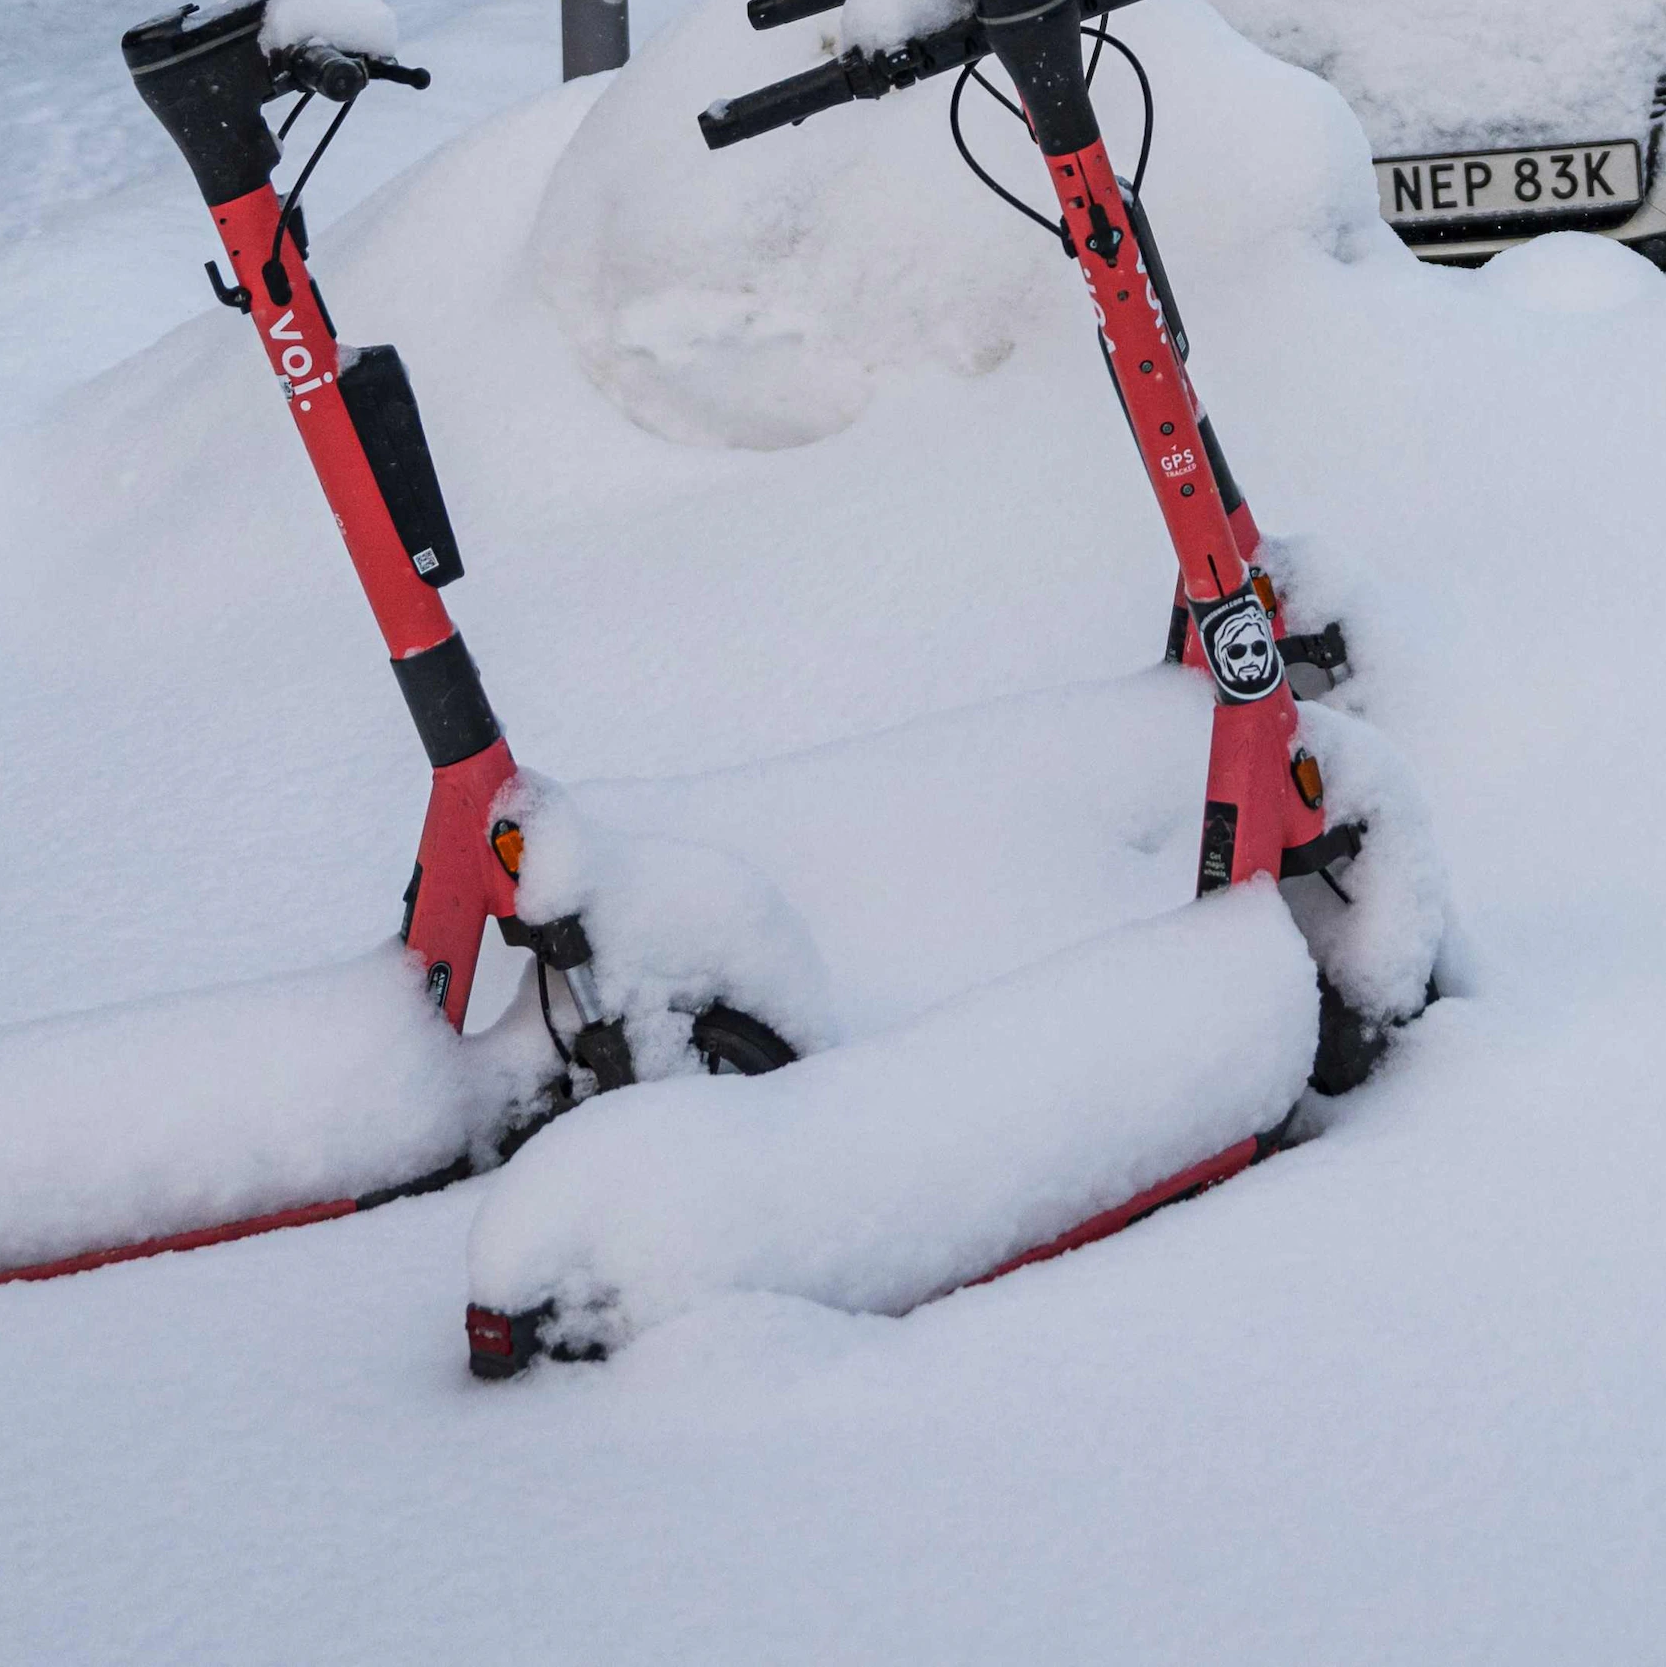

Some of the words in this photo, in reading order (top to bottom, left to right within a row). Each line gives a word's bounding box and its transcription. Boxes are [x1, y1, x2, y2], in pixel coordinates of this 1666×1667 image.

[1392, 160, 1493, 212] NEP
[1514, 150, 1615, 202] 83K
[1161, 448, 1194, 471] GPS
[1165, 462, 1197, 478] TRACKED
[1209, 851, 1221, 860] Get
[1205, 861, 1226, 869] magic
